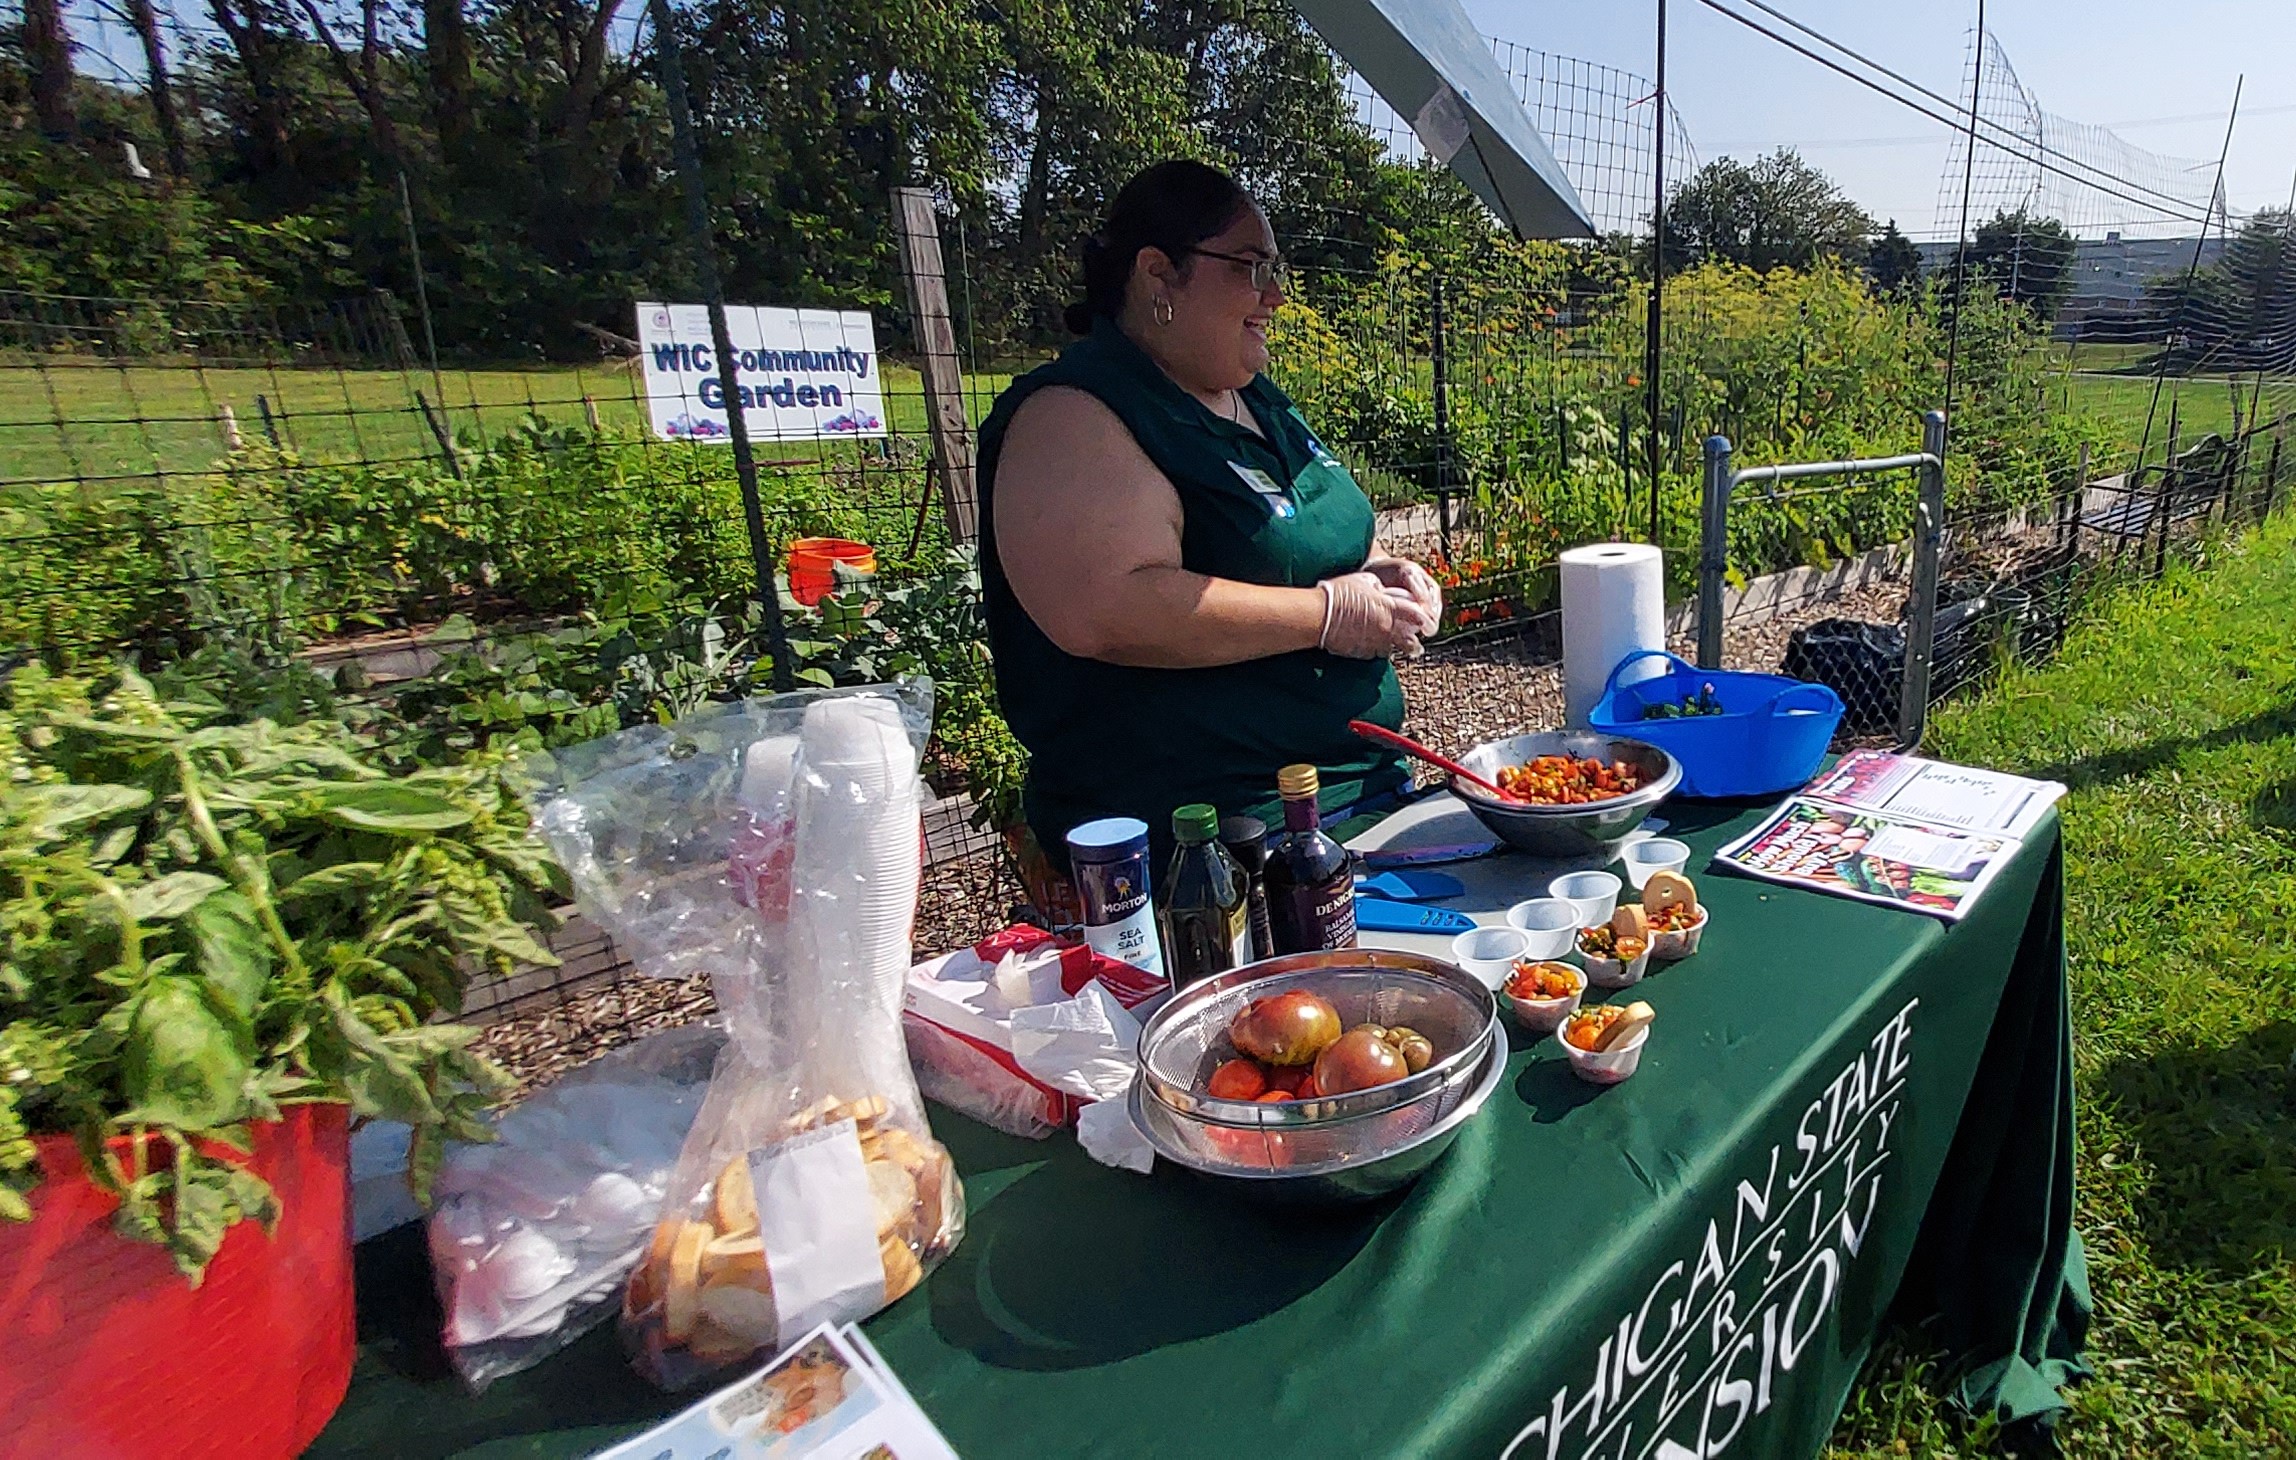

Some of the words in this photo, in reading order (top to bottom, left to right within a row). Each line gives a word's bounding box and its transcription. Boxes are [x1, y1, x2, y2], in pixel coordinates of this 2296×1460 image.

[650, 342, 712, 372] WIC
[699, 377, 843, 410] Garden
[1746, 844, 1784, 868] How
[1771, 820, 1812, 848] Much
[1101, 892, 1147, 914] MORTON
[1117, 935, 1145, 950] SALT
[1118, 927, 1142, 941] SEA
[1788, 997, 1919, 1190] STATE
